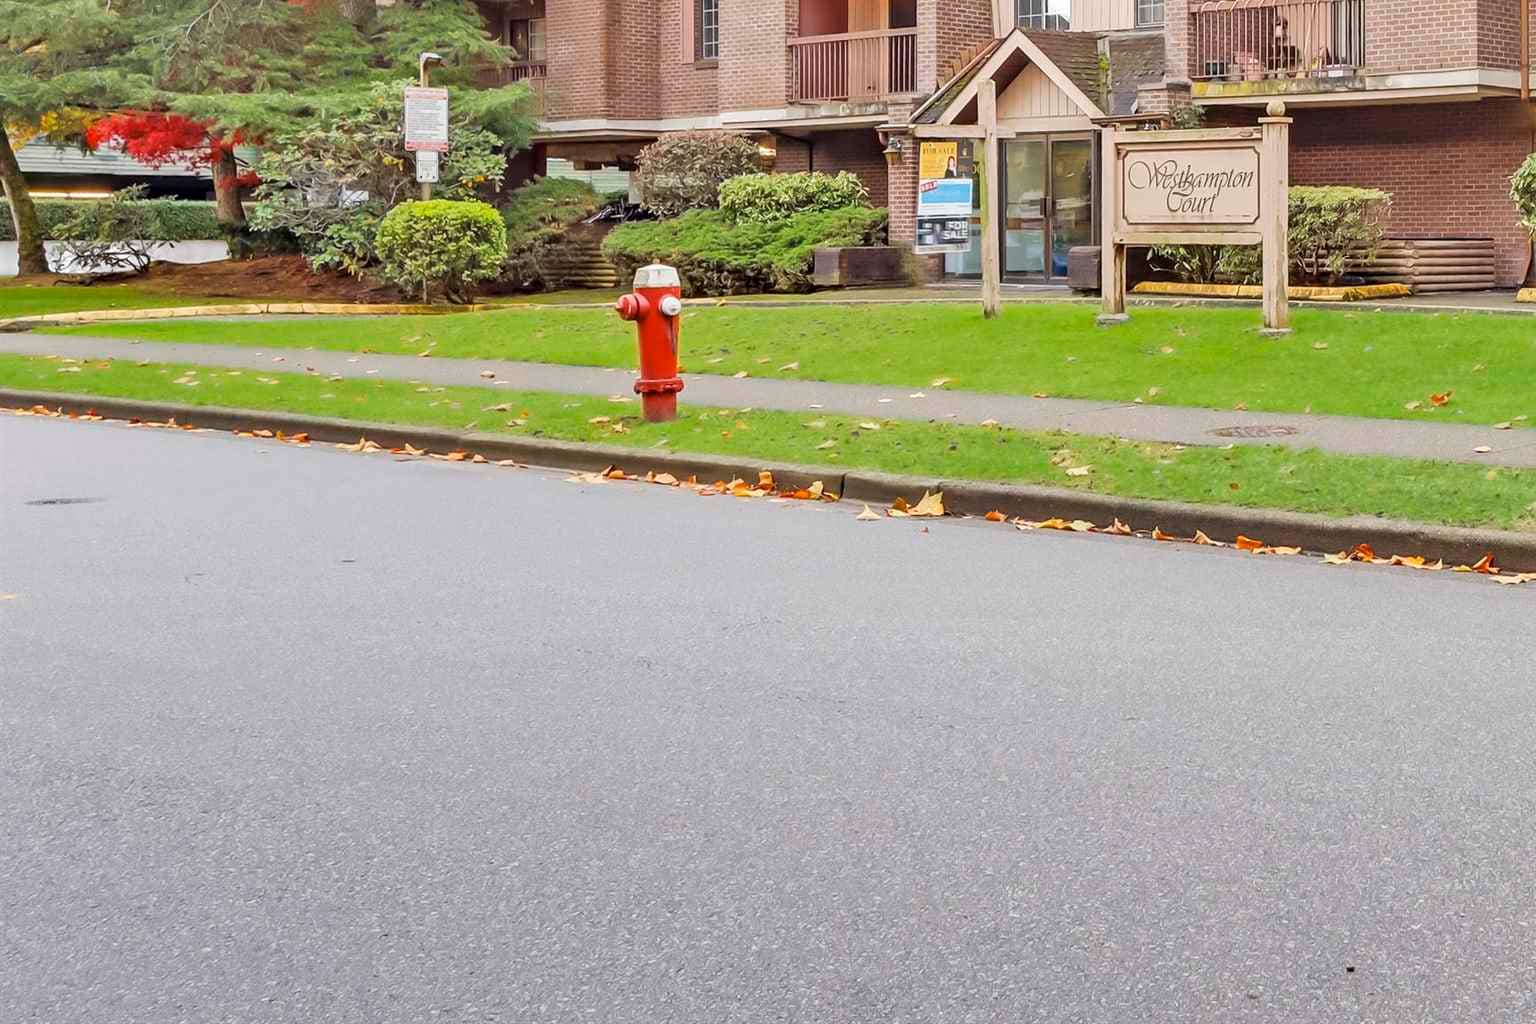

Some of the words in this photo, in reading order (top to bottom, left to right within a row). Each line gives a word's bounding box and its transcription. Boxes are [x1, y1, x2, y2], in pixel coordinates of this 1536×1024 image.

[1128, 160, 1254, 196] Westhampton
[1166, 187, 1217, 214] Court
[946, 221, 968, 230] FOR
[943, 230, 969, 240] SALE
